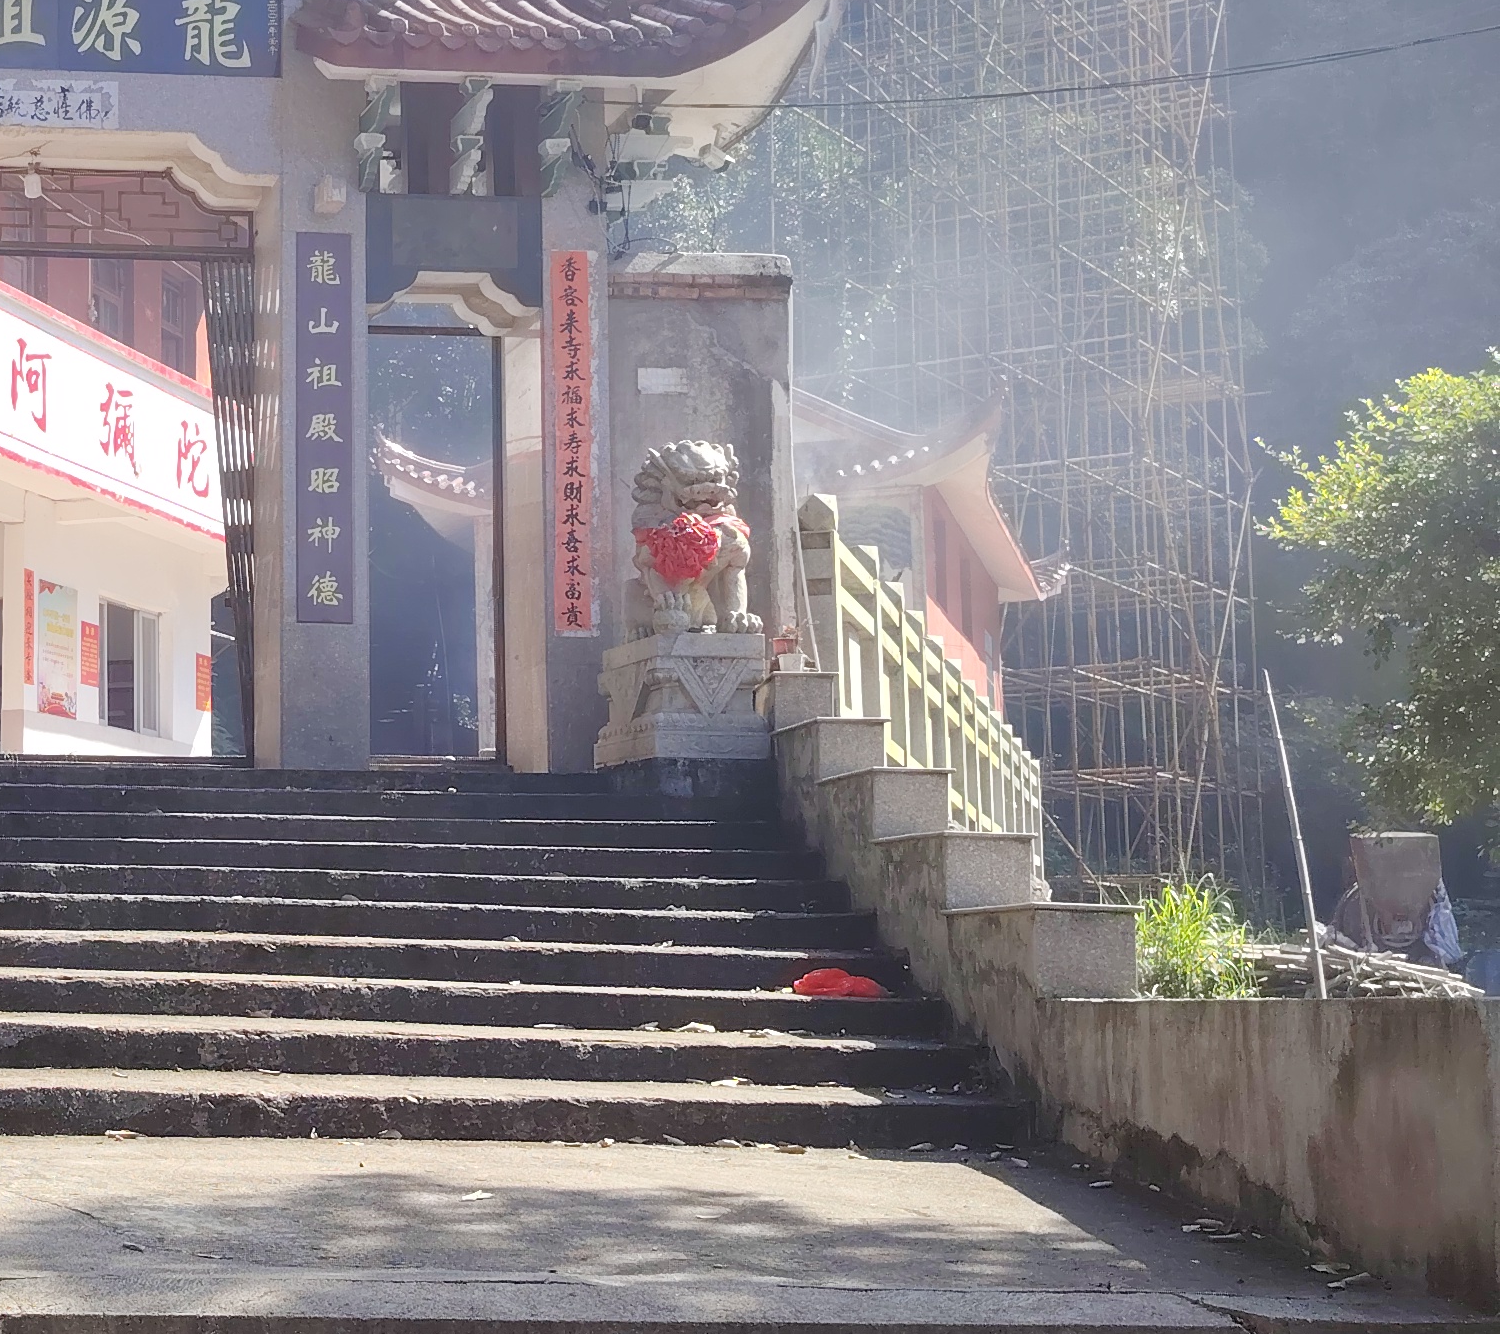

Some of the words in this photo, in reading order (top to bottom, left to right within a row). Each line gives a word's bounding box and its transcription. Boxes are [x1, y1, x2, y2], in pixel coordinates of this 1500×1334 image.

[305, 250, 344, 606] 龍山祖殿昭神德
